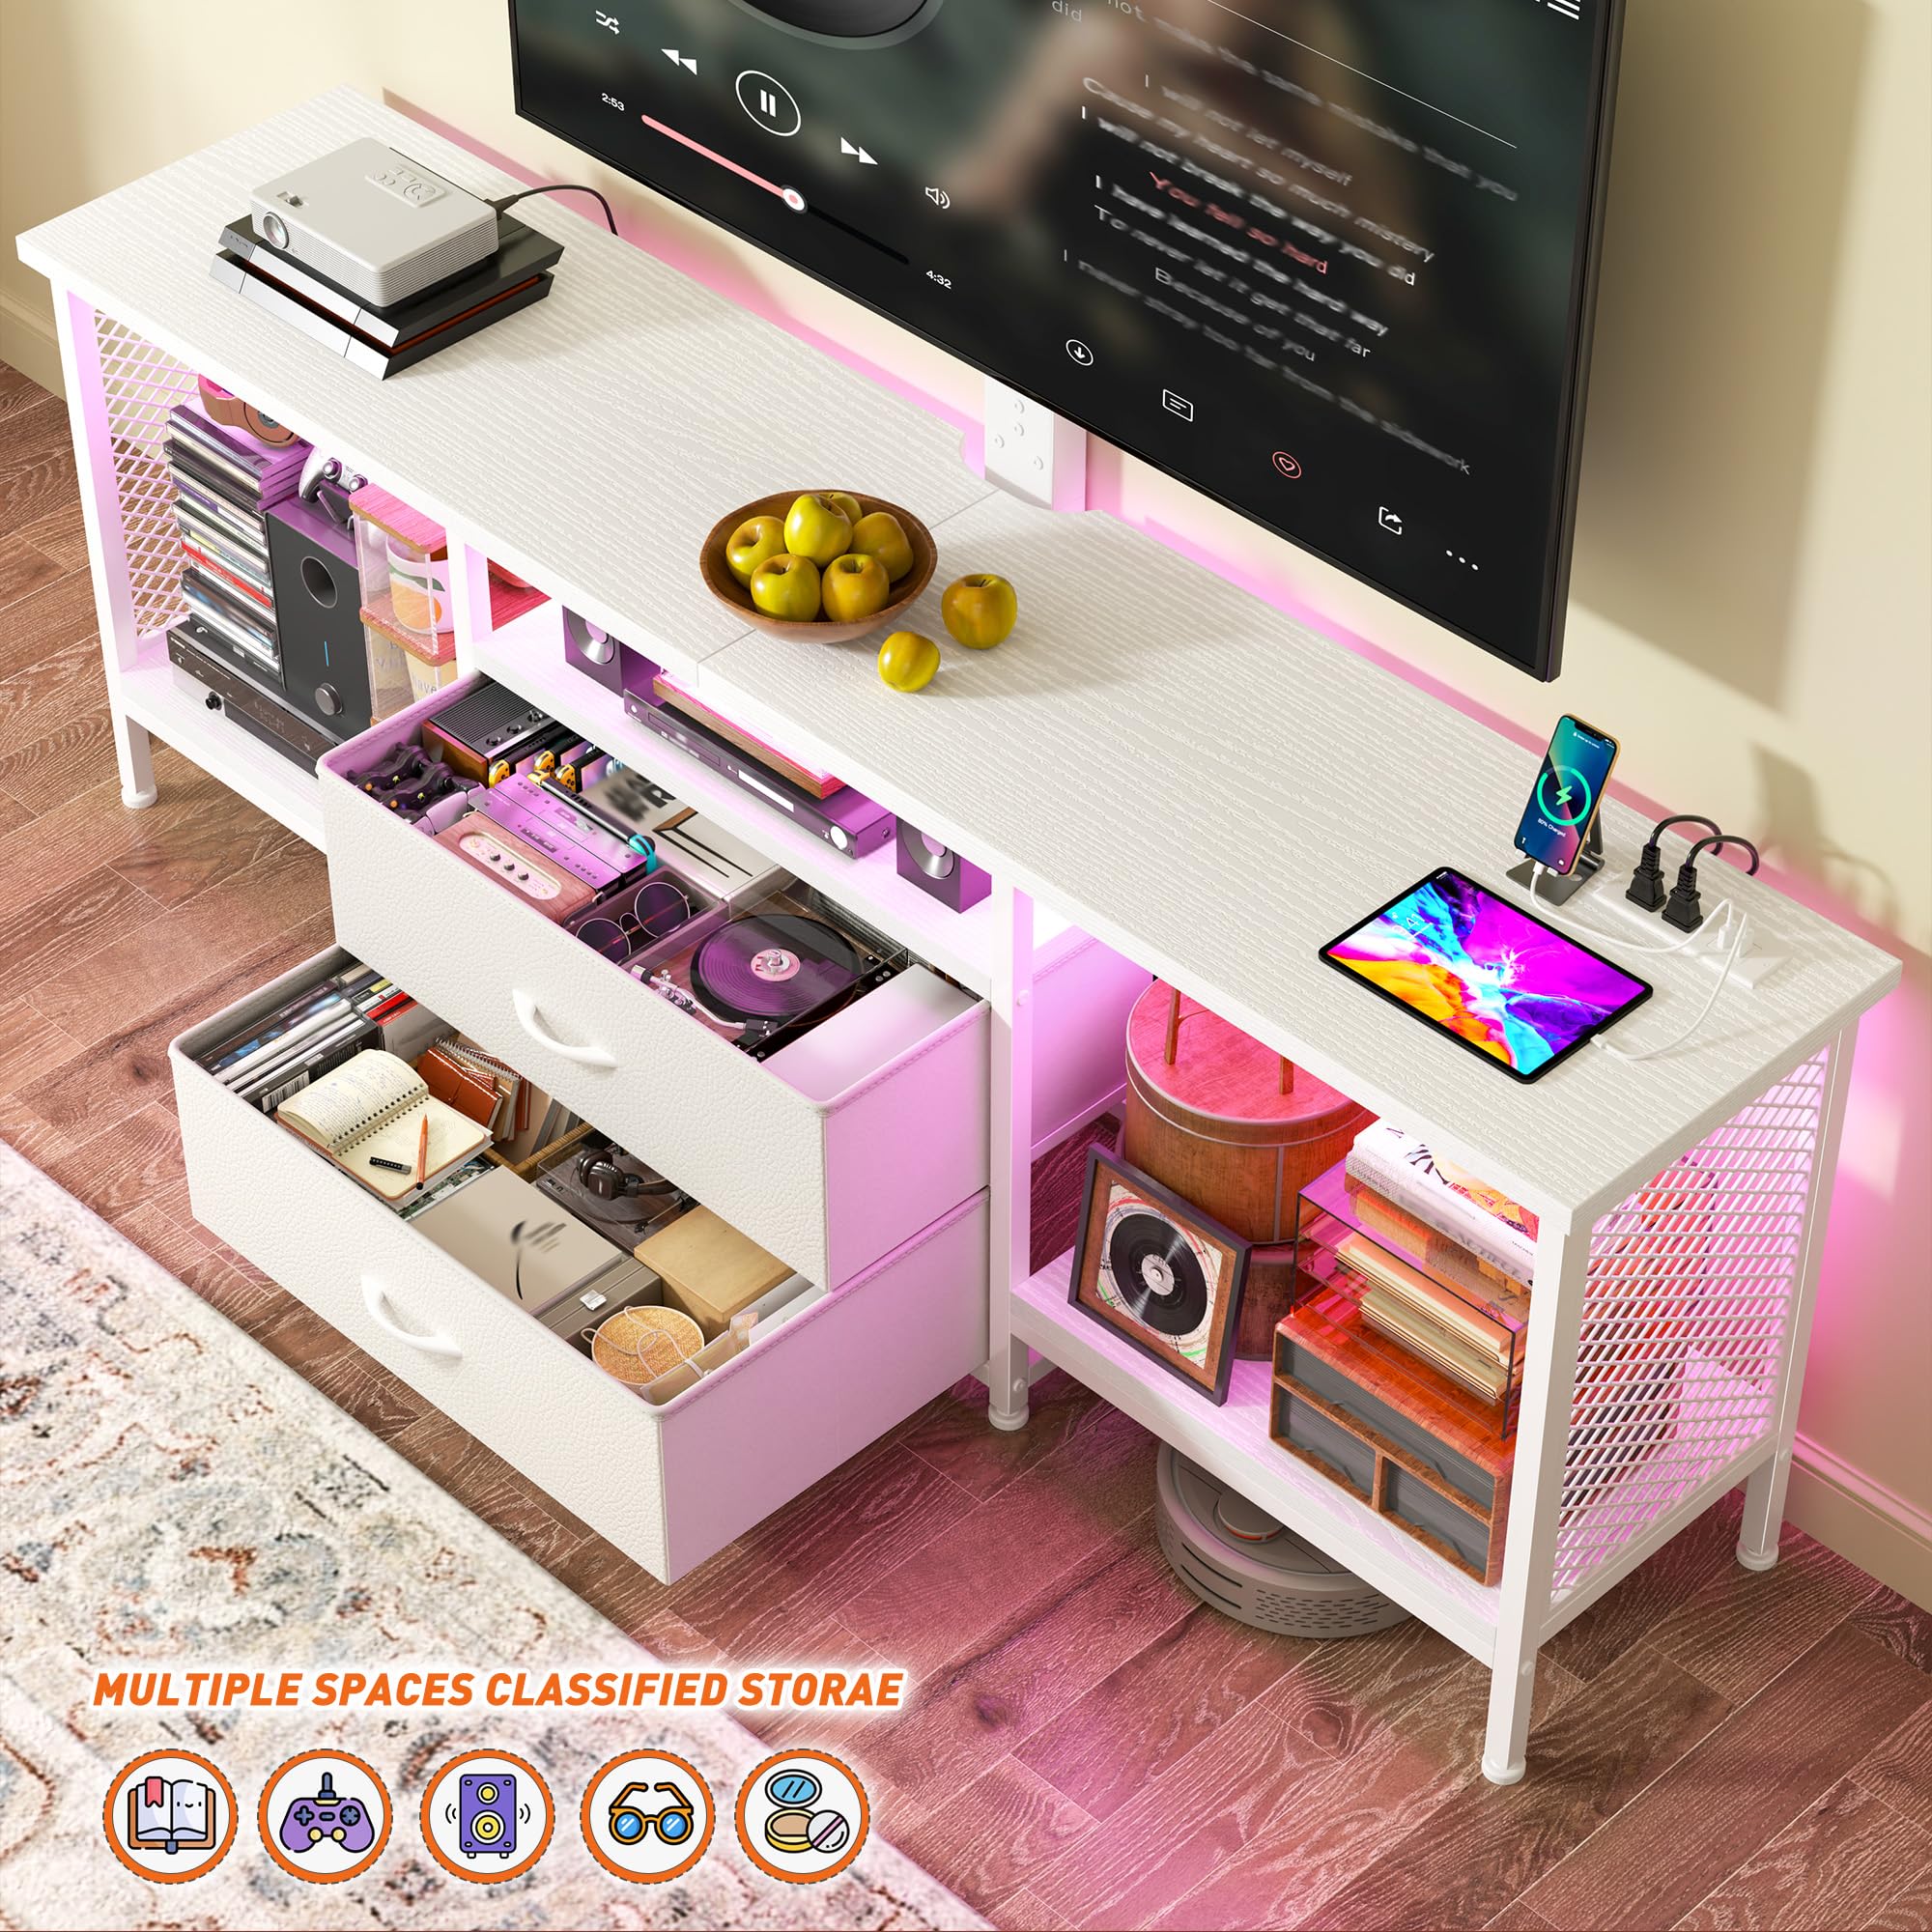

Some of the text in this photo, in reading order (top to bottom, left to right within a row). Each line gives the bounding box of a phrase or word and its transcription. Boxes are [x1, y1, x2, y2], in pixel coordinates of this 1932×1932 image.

[1052, 0, 1082, 22] did
[601, 93, 625, 111] 2:53
[1082, 76, 1155, 121] Cause
[1256, 165, 1286, 185] so
[1288, 184, 1351, 218] much
[1145, 74, 1150, 88] I
[1280, 147, 1352, 185] myself
[1082, 105, 1087, 120] I
[1180, 157, 1244, 197] break
[1247, 193, 1288, 218] the
[1291, 214, 1338, 244] way
[1339, 241, 1384, 268] you
[1386, 264, 1415, 286] did
[1149, 171, 1201, 208] You
[1246, 226, 1280, 247] so
[1280, 242, 1328, 274] hard
[926, 270, 952, 289] 4:32
[1064, 248, 1067, 262] I
[1094, 204, 1128, 231] To
[1129, 228, 1194, 263] never
[1250, 291, 1292, 316] get
[1344, 337, 1371, 357] far
[1095, 174, 1101, 189] I
[1112, 182, 1166, 220] have
[1252, 257, 1292, 285] the
[1293, 277, 1348, 313] hard
[1349, 309, 1389, 337] way
[1155, 267, 1250, 325] Because
[1281, 338, 1316, 361] you
